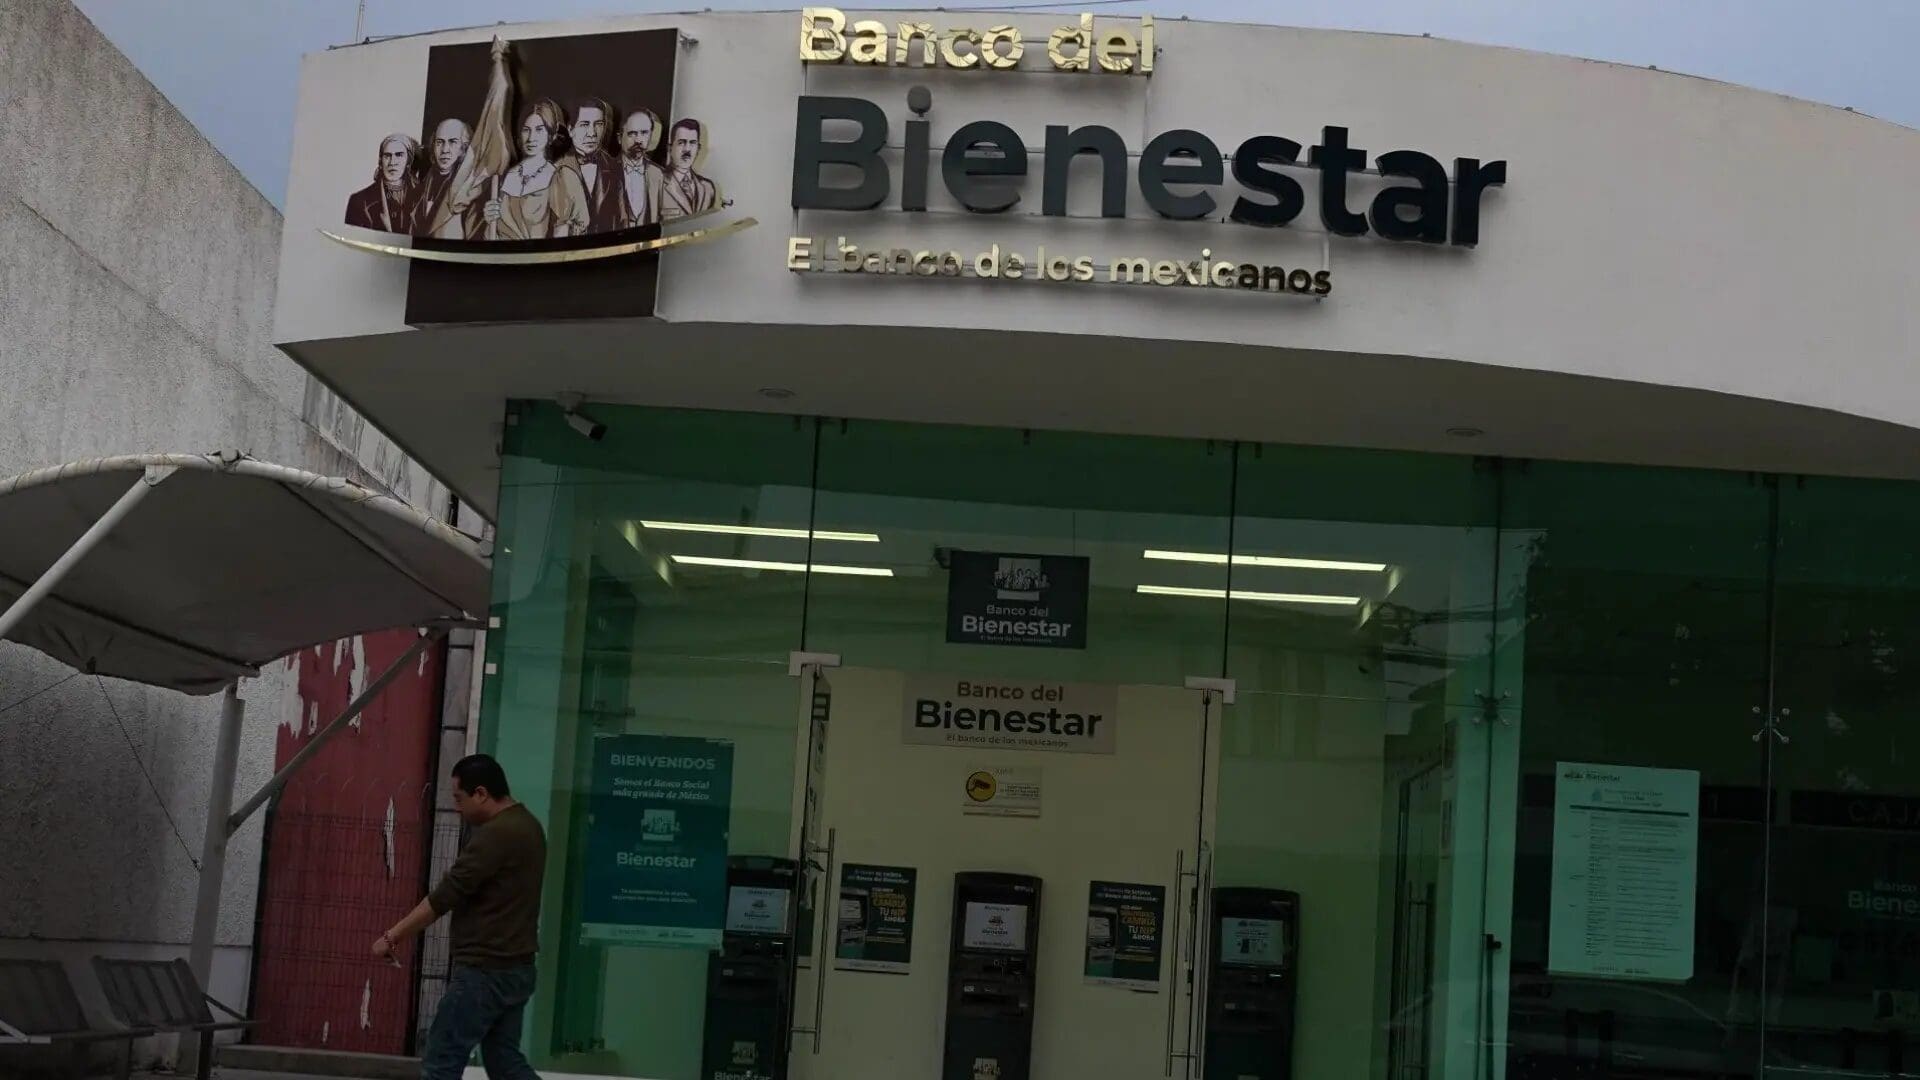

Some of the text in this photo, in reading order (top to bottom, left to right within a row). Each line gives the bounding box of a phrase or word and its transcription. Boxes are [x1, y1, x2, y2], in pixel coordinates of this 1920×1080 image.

[800, 7, 1155, 74] Banco del
[792, 86, 1507, 246] Bienestar
[787, 237, 1332, 297] El banco de los mexicanos
[986, 604, 1049, 617] Banco del
[962, 615, 1071, 638] Bienestar
[957, 681, 1064, 702] Banco del
[914, 699, 1102, 738] Bienestar
[610, 754, 716, 770] BIENVENIDOS
[616, 851, 696, 868] Bienestar
